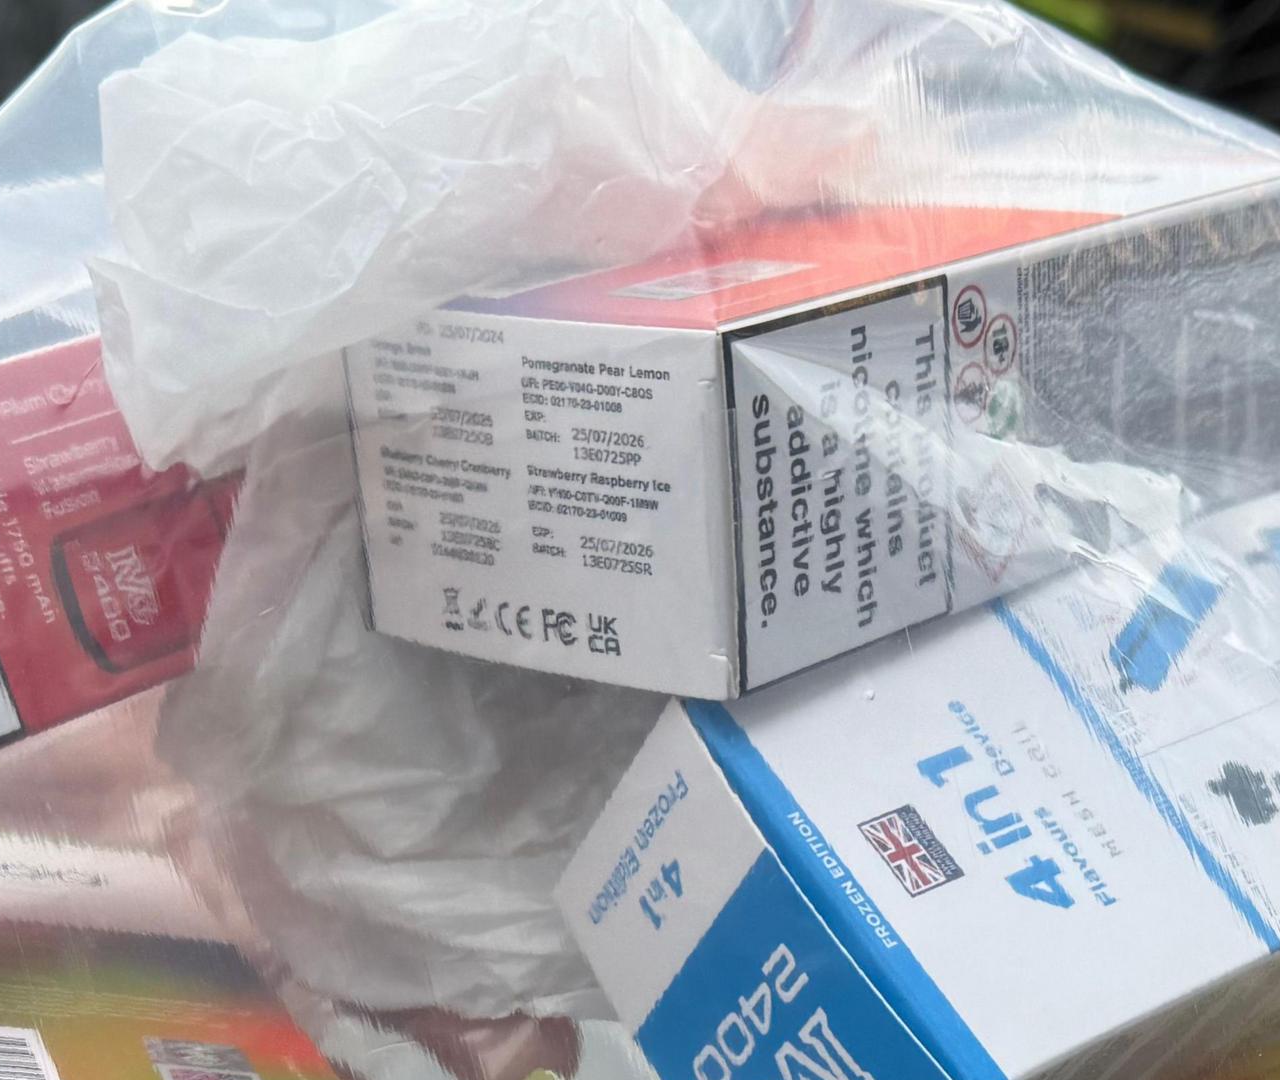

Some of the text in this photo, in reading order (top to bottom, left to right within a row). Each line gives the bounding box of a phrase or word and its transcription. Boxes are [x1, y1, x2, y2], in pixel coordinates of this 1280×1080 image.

[521, 356, 670, 381] Pomegranate Pear Lemon
[526, 428, 644, 448] BATCH: 25/07/2026
[527, 465, 671, 493] Strawberry Raspberry Ice
[574, 447, 642, 466] 13E0725PP
[786, 404, 810, 598] addictive
[823, 431, 839, 457] a
[850, 325, 878, 629] nicotine which
[580, 535, 654, 558] 25/07/2026
[752, 393, 777, 629] substance.
[820, 468, 846, 596] highly
[587, 769, 689, 925] Frozen Edition
[917, 745, 1075, 909] 4 in 1
[948, 700, 1118, 907] Flavours Device
[1061, 789, 1123, 859] MESH
[788, 812, 898, 949] FROZEN EDITION
